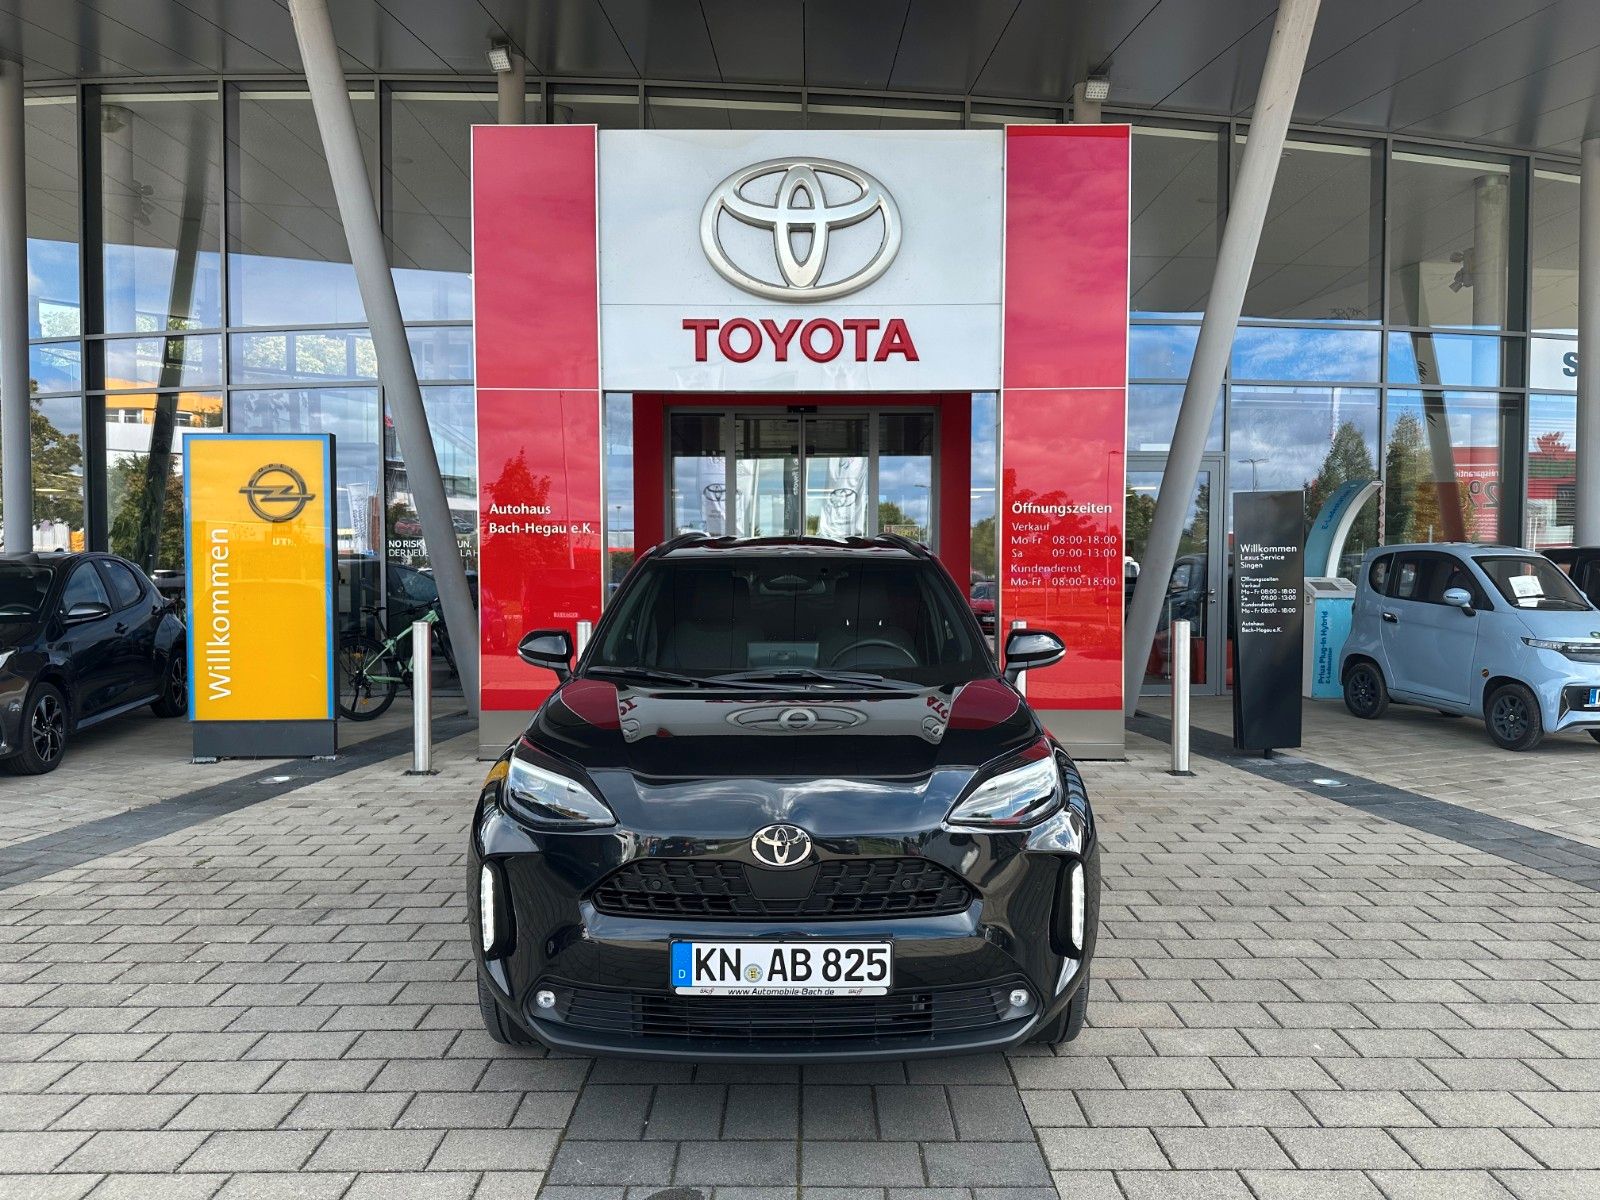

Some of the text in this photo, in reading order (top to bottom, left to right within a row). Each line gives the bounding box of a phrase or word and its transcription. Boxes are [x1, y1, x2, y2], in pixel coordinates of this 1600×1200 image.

[682, 317, 920, 363] TOYOTA
[489, 503, 551, 515] Autohaus
[1011, 501, 1112, 517] Öffnungszeiten
[489, 522, 595, 536] Bach-Hegau e.K.
[1011, 522, 1050, 531] Verkauf
[388, 540, 402, 548] NO
[1011, 535, 1117, 544] Mo-Fr 08:00-18:00
[388, 549, 406, 557] DER
[1011, 548, 1117, 558] Sa 09:00-13:00
[1240, 544, 1297, 553] Willkommen
[1010, 564, 1082, 573] Kundendienst
[1240, 561, 1263, 569] Singen
[1010, 577, 1117, 586] Mo-Fr 08:00-18:00
[206, 528, 231, 701] Willkommen
[1320, 611, 1329, 636] Hybrid
[1318, 664, 1326, 685] Prius
[678, 948, 888, 982] D KN AB 825
